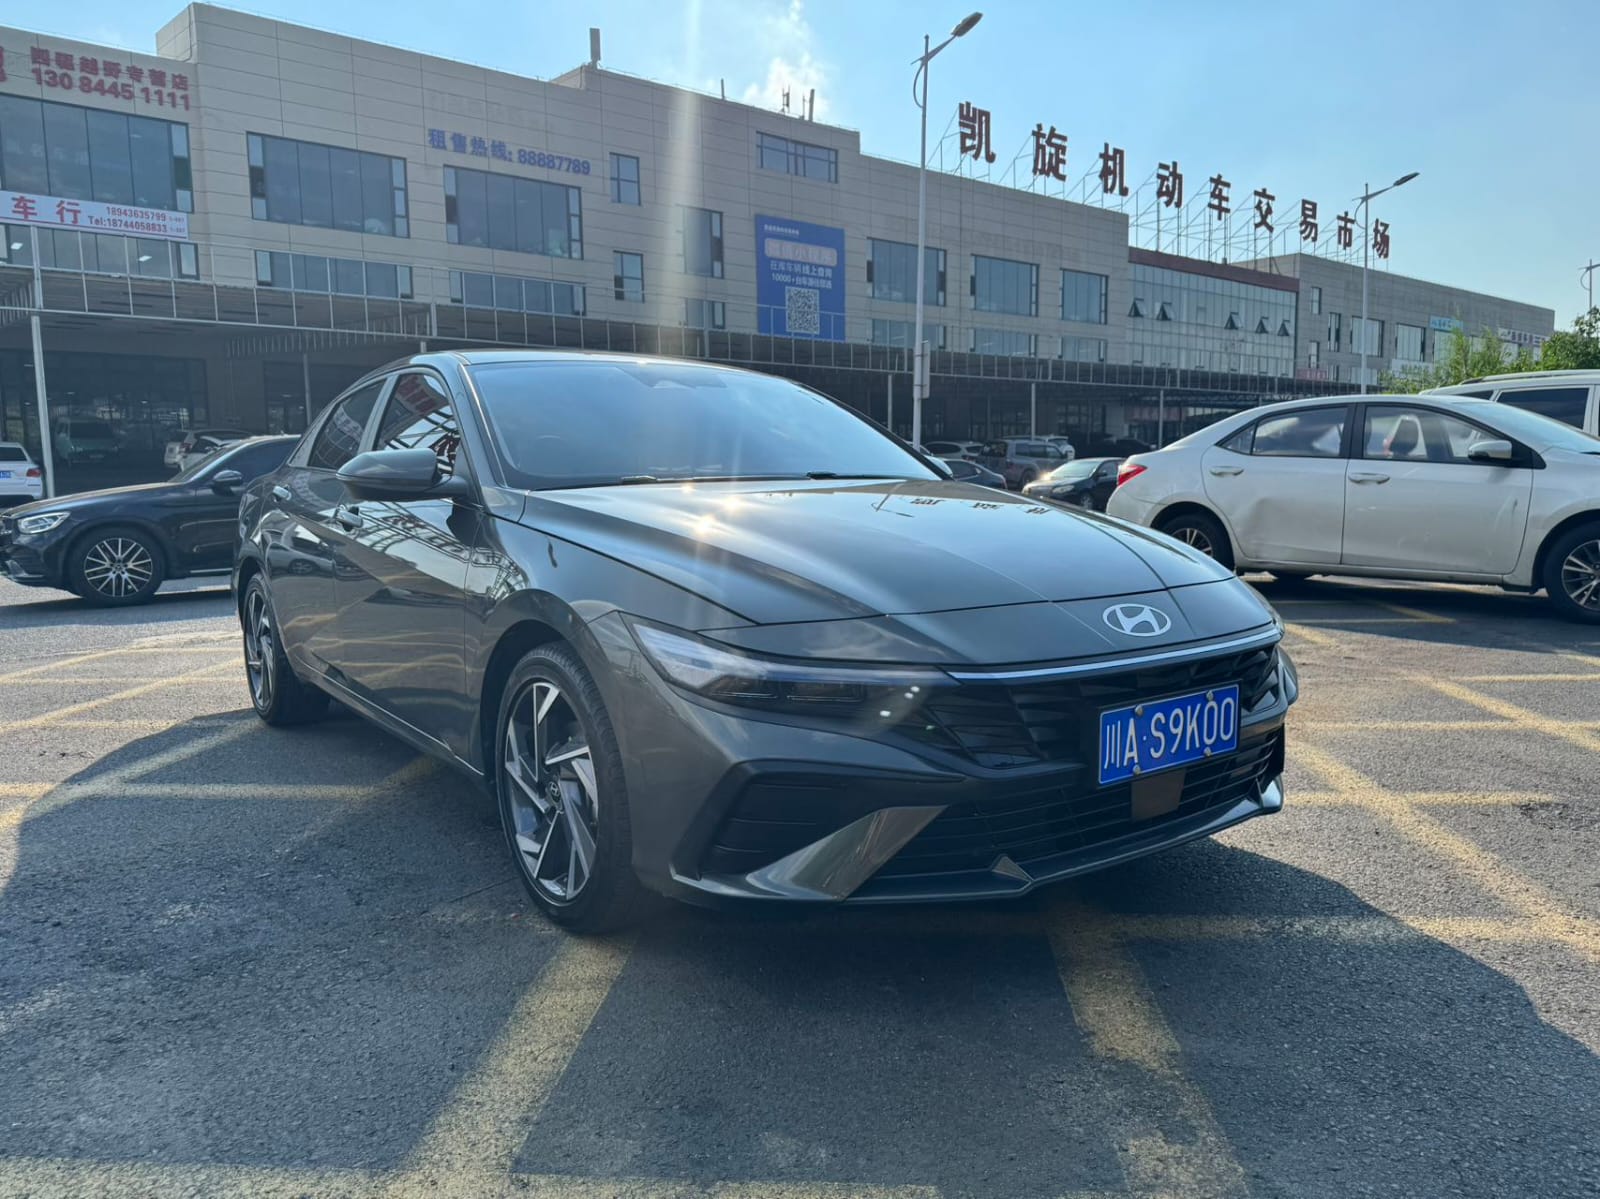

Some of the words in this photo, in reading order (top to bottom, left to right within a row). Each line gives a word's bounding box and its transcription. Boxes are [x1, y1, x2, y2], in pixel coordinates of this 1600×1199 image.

[31, 67, 73, 90] 130
[78, 76, 135, 101] 8445
[140, 87, 190, 111] 1111
[958, 101, 1391, 259] 凯旋机动车交易市场
[12, 196, 81, 224] 车行
